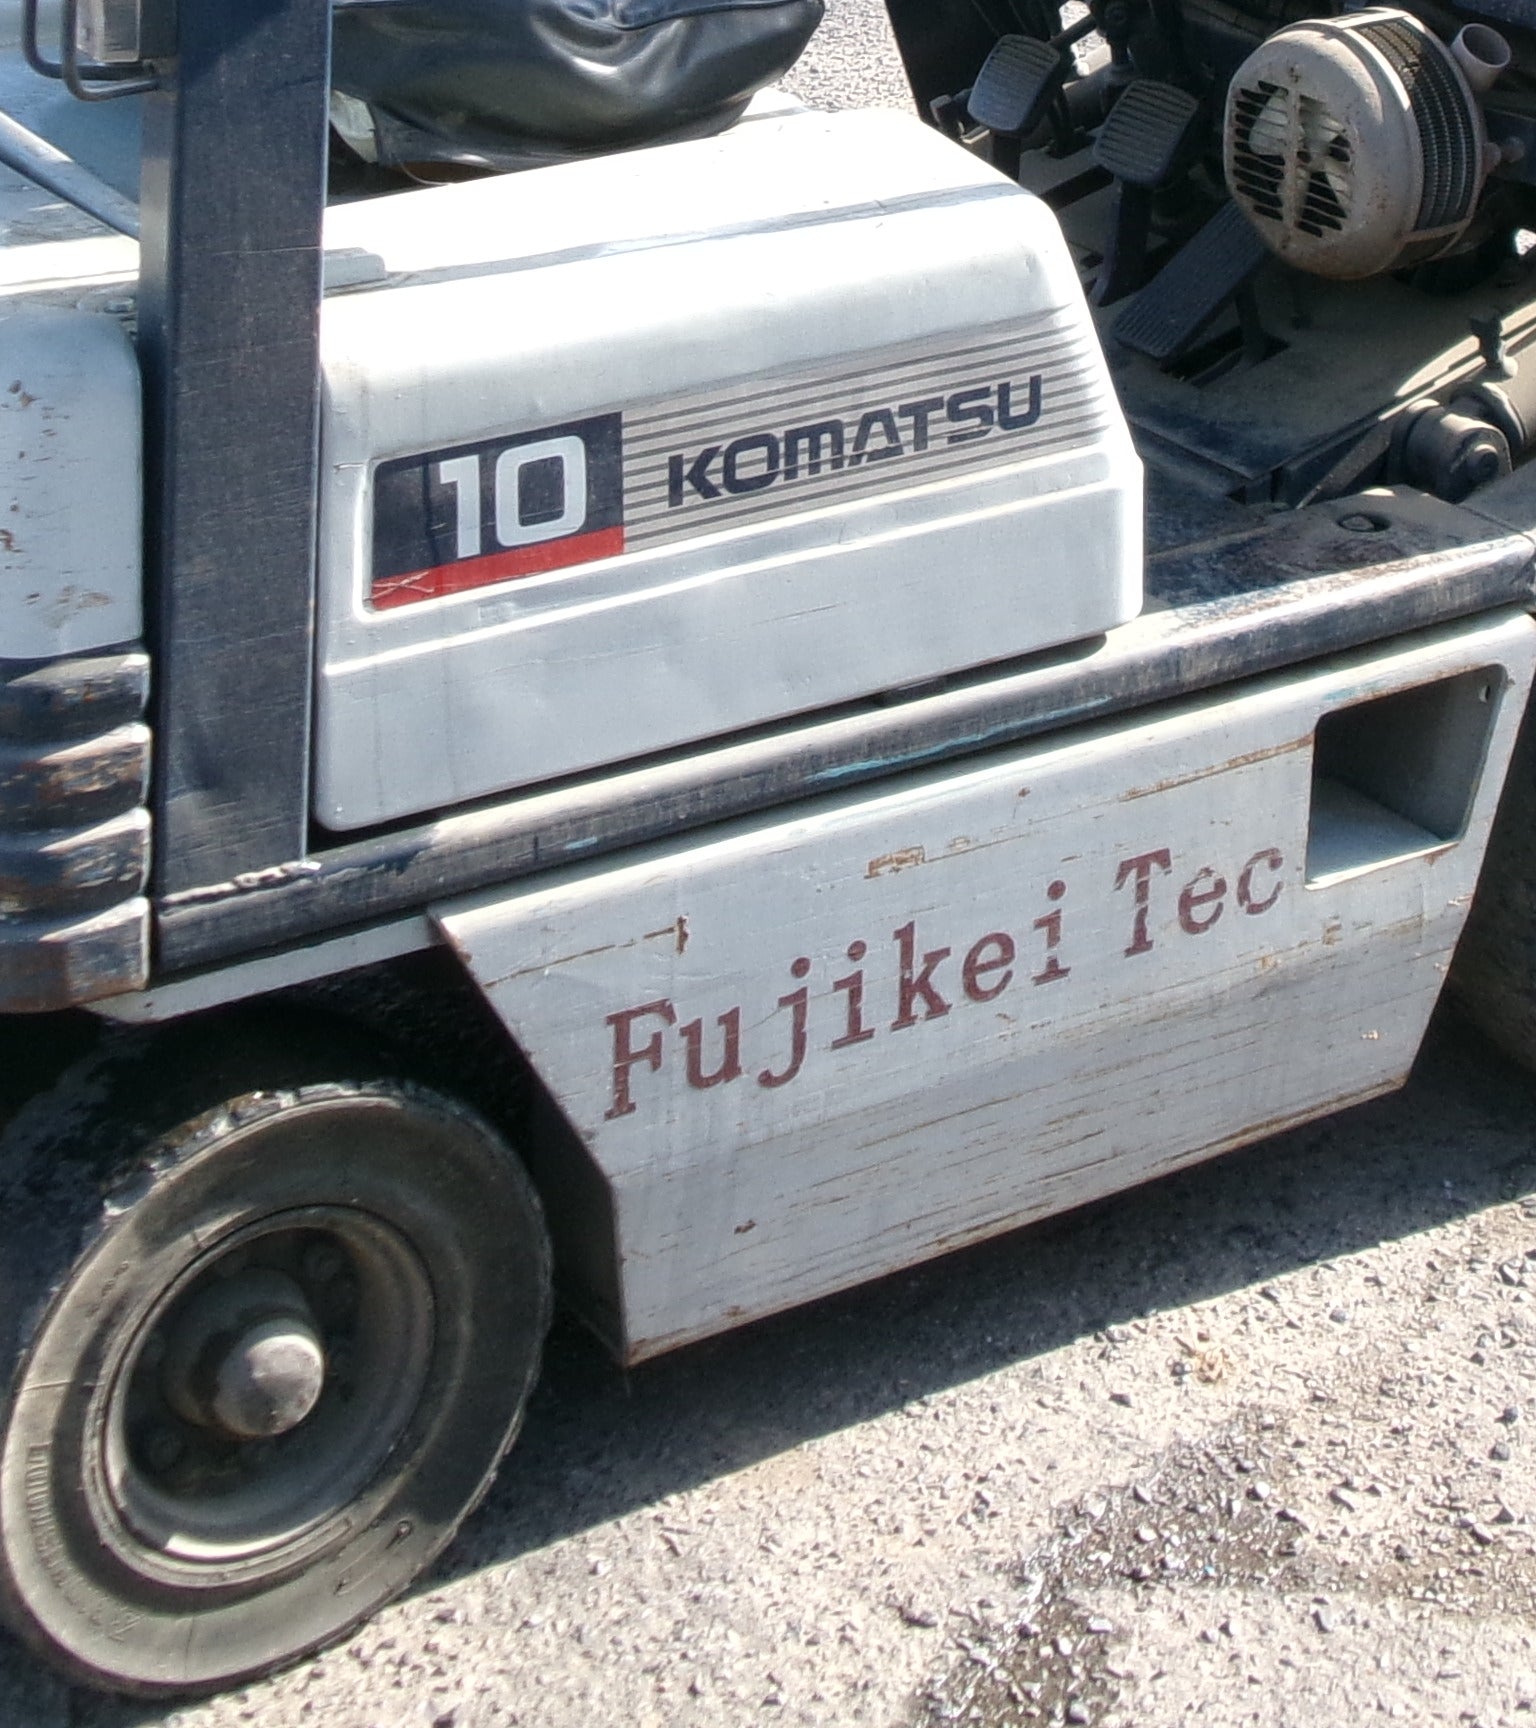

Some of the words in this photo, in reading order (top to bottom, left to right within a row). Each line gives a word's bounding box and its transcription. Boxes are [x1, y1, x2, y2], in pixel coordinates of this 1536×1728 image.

[438, 434, 587, 560] 10
[666, 374, 1043, 508] KOMATSU
[602, 878, 1072, 1121] Fujikei
[1113, 846, 1286, 959] Tec
